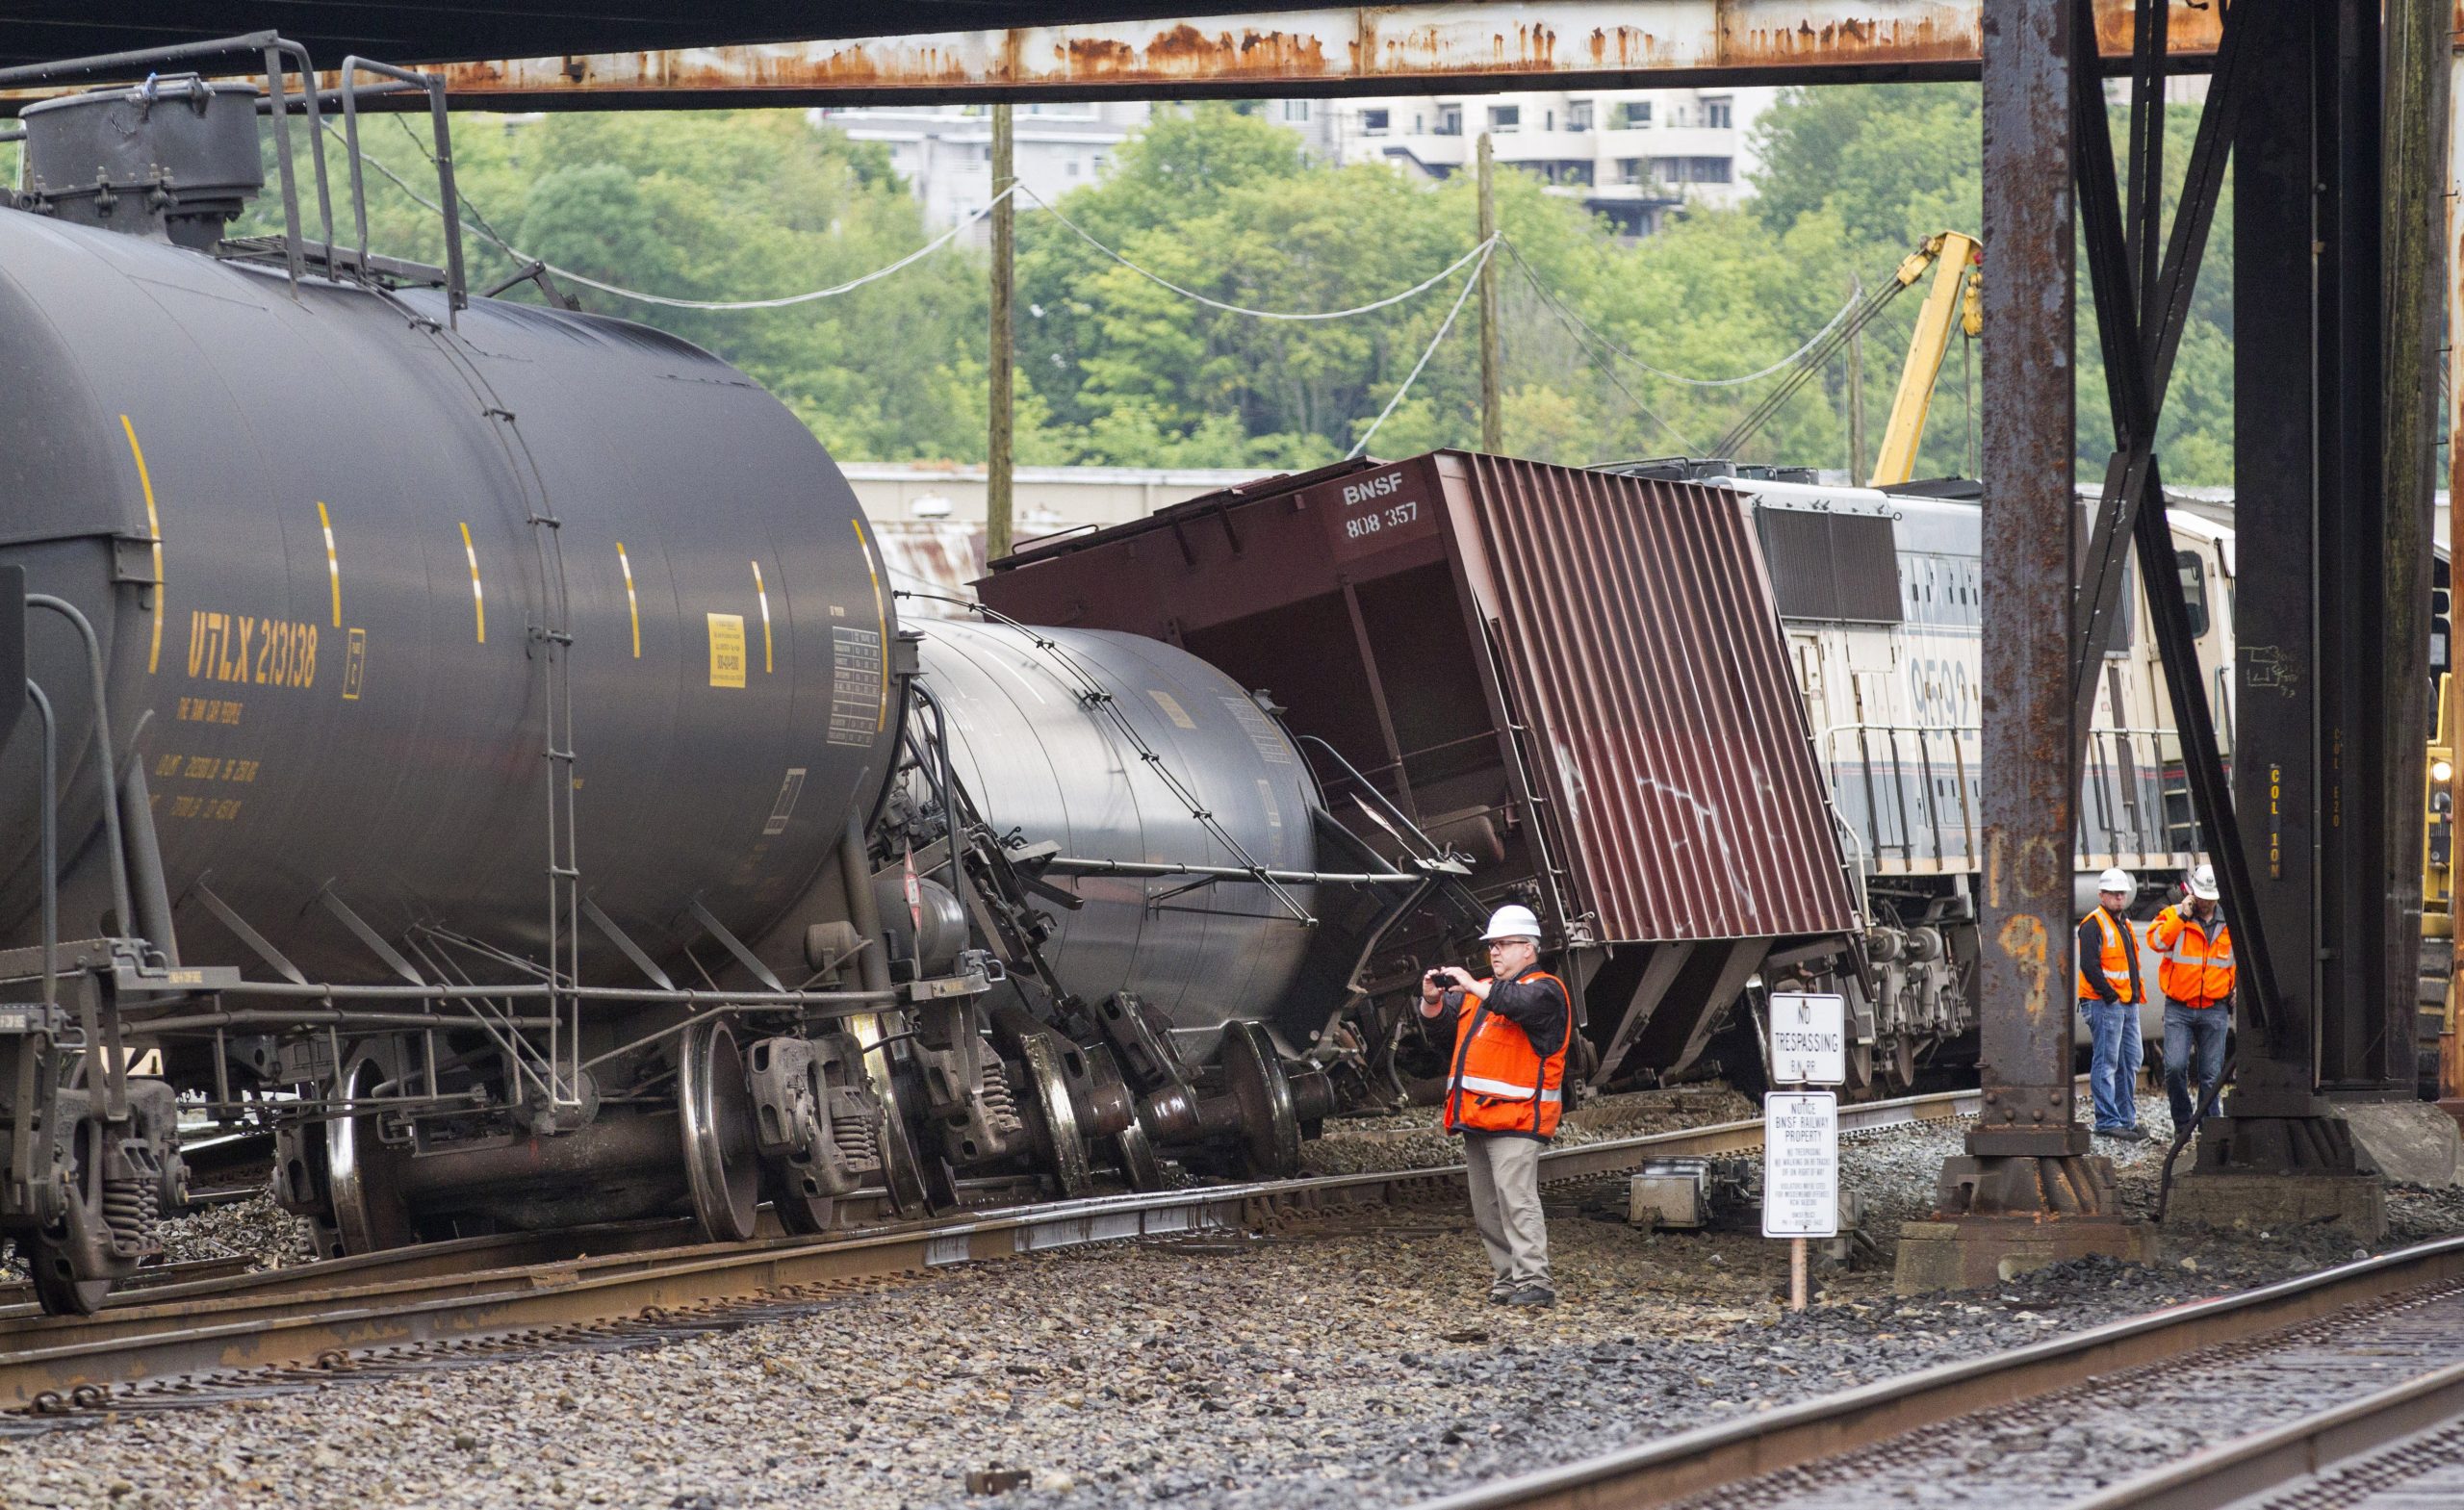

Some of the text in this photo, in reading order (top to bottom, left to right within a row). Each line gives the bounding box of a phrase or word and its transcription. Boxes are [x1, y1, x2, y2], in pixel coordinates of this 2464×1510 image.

[1343, 472, 1402, 505] BNSF
[1347, 501, 1417, 539] 808 357
[188, 610, 318, 689] UTLX 213138
[2271, 769, 2280, 814] COL
[1797, 1006, 1810, 1025] NO
[1775, 1032, 1838, 1053] TRESPASSING
[1791, 1103, 1816, 1114] NOTICE
[1776, 1116, 1829, 1129] BNSF RAILWAY
[1785, 1130, 1822, 1142] PROPERTY
